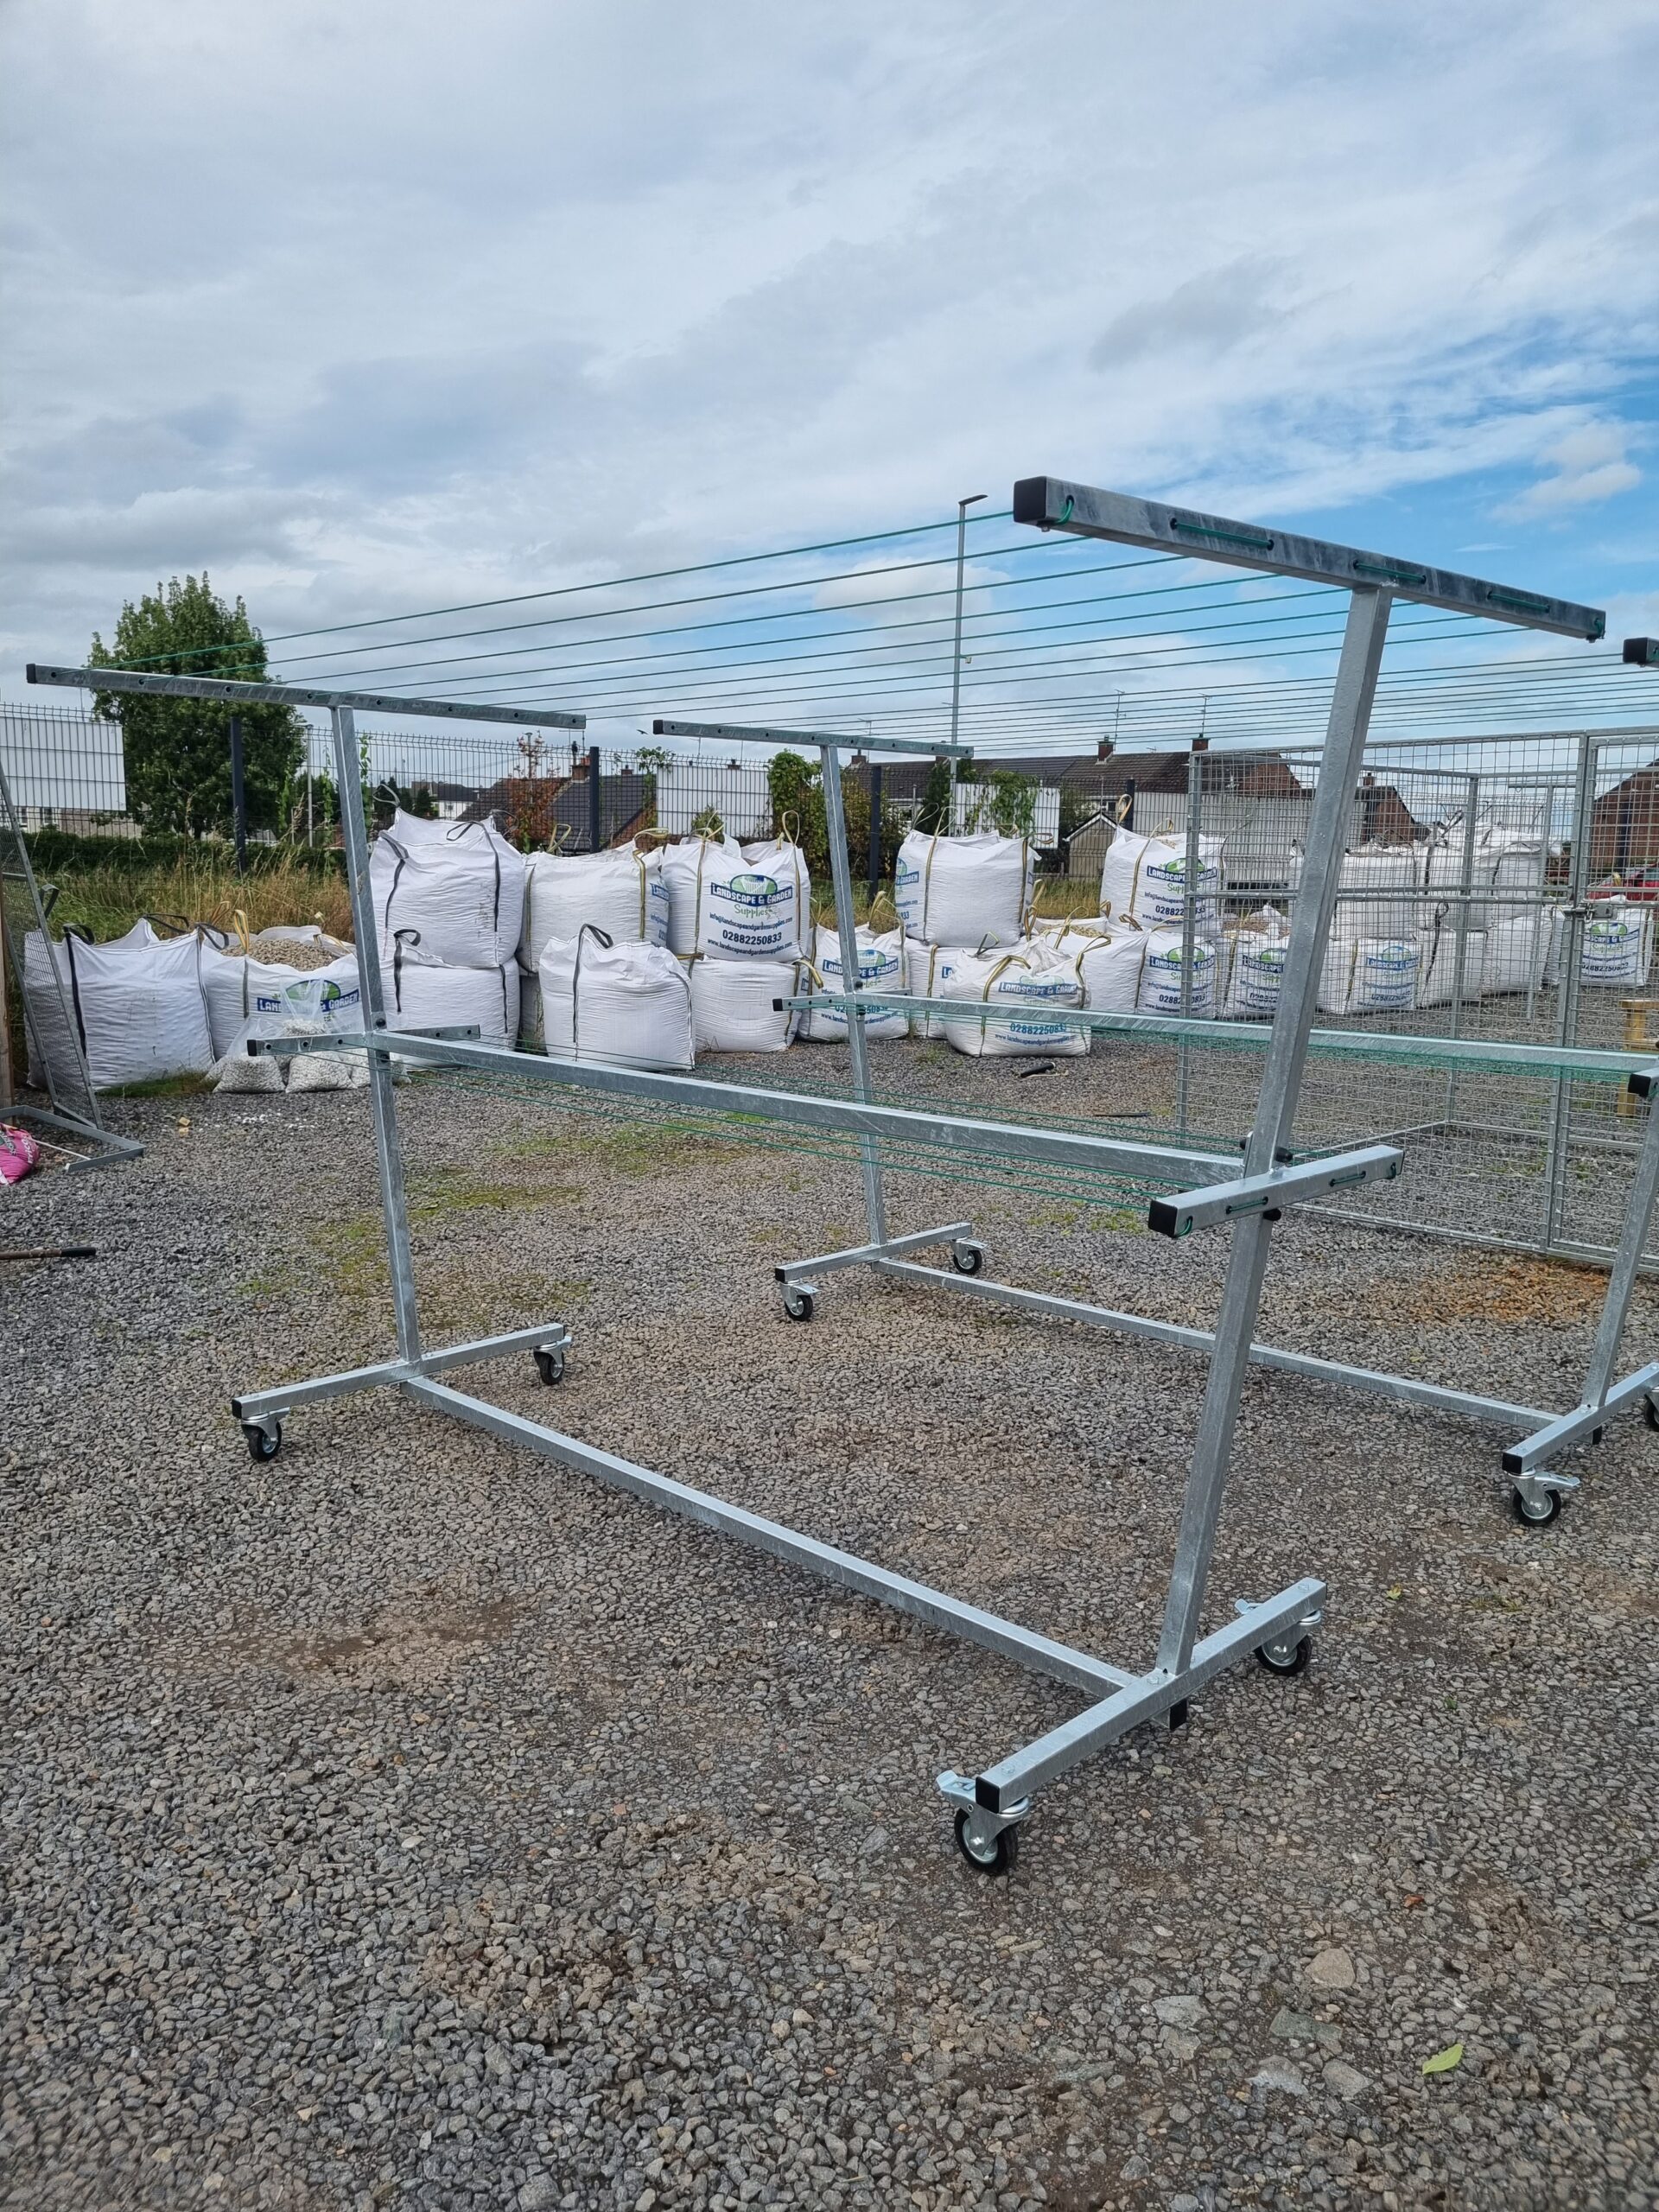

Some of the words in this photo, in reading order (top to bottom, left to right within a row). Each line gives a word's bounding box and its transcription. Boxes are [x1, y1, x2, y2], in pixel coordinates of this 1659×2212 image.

[712, 883, 757, 905] LANDSCAPE
[758, 896, 765, 905] &
[766, 887, 793, 904] GARDEN
[734, 904, 768, 918] Supplies
[722, 929, 782, 945] 02882250833
[1151, 956, 1181, 970] LANDSCA
[328, 991, 359, 1009] GARDEN
